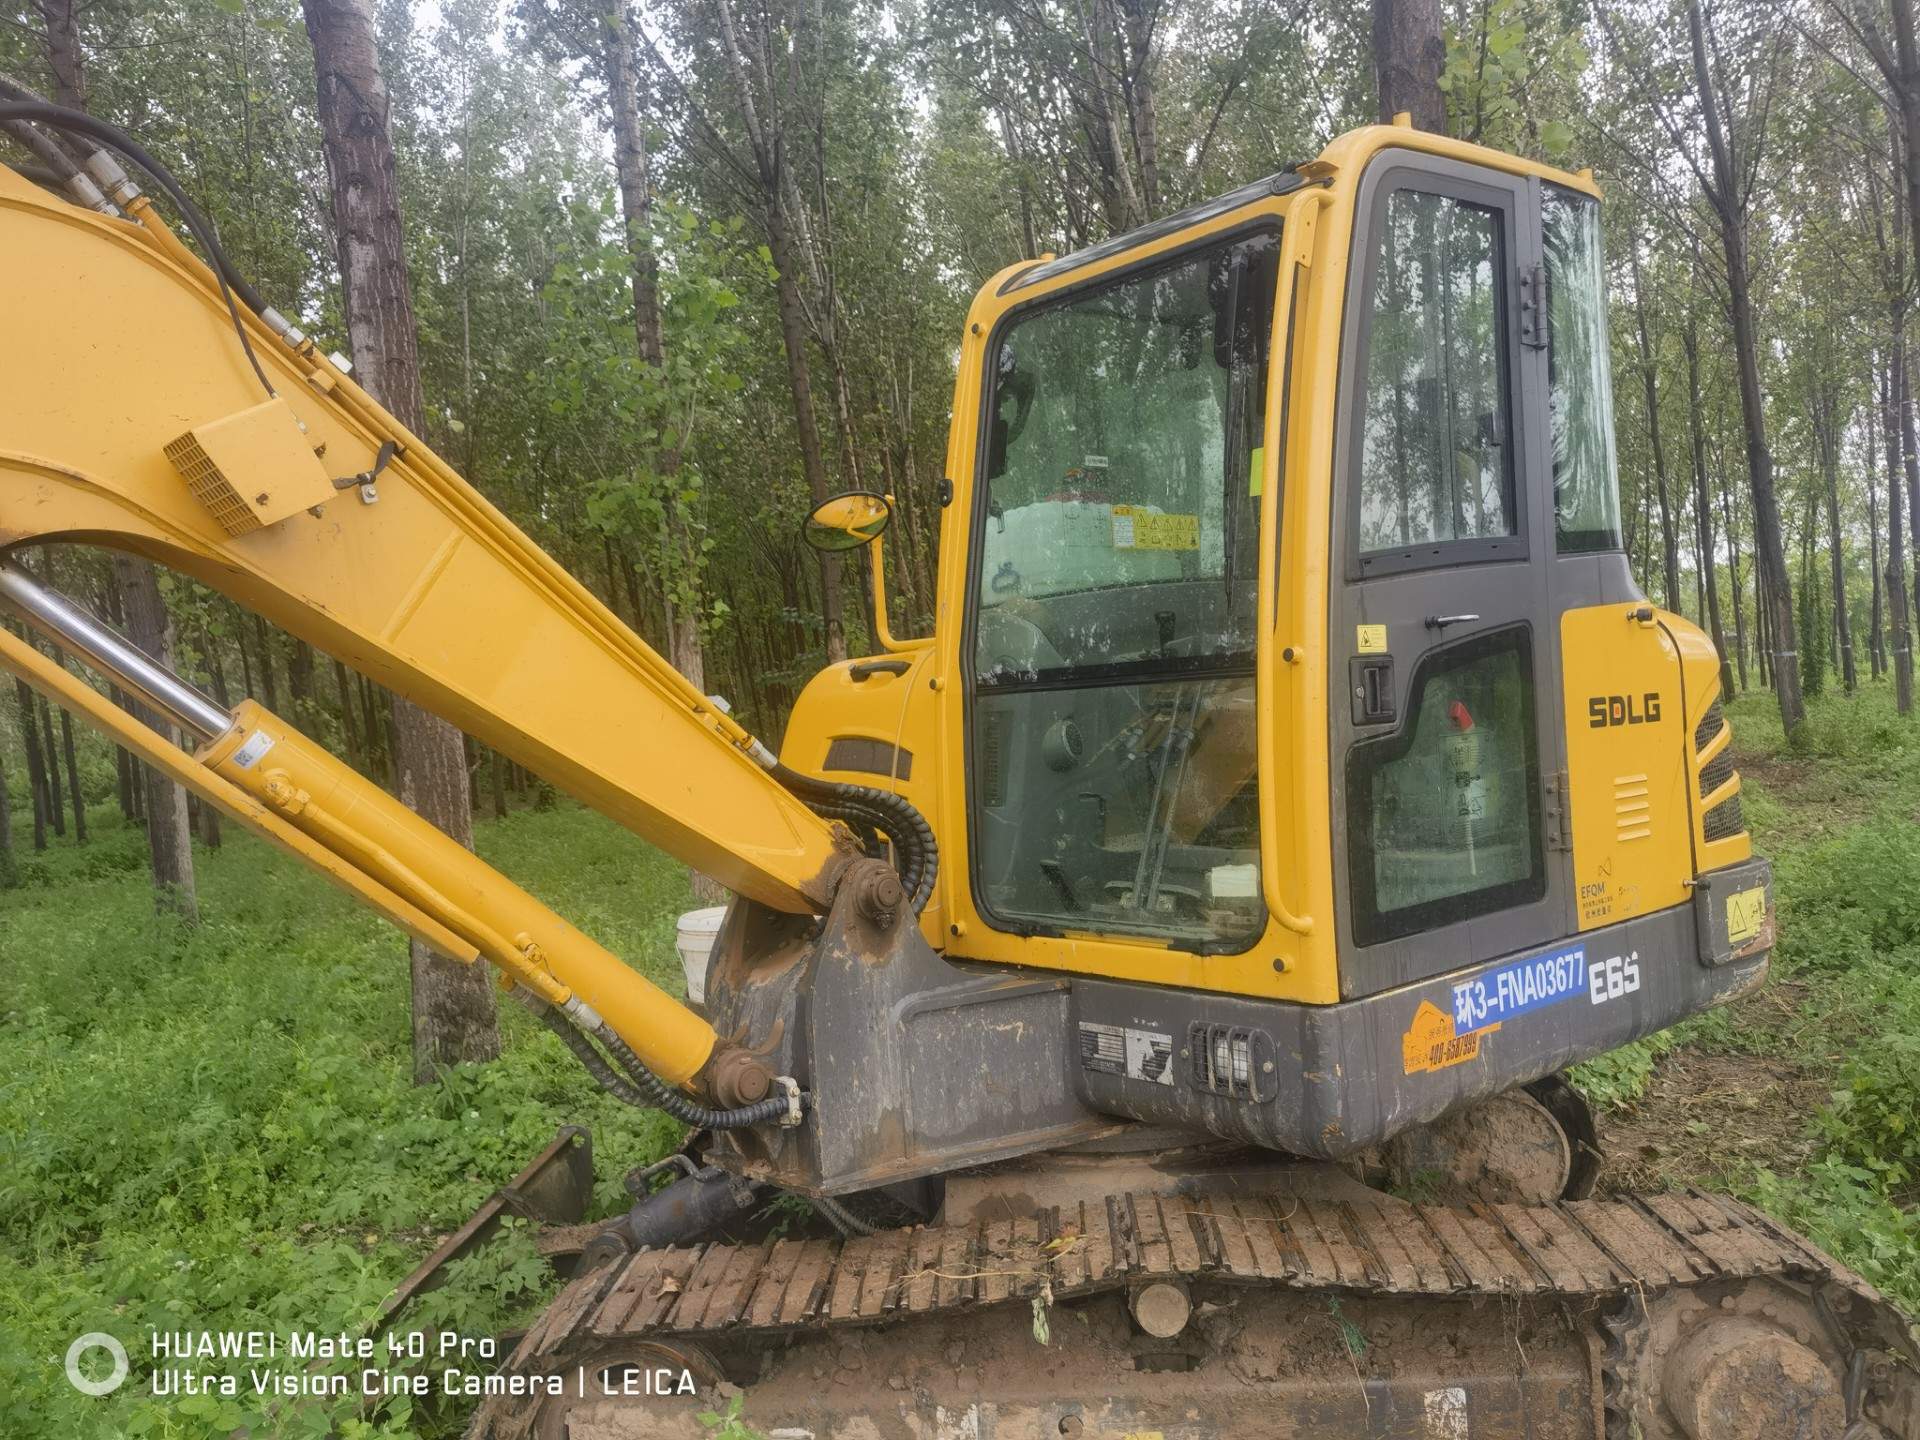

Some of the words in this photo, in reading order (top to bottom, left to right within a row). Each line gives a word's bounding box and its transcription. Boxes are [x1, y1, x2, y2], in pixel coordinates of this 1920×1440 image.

[1589, 692, 1661, 728] SDLG
[1580, 881, 1606, 899] EFQM
[1453, 951, 1584, 1028] 环3-FNA03677
